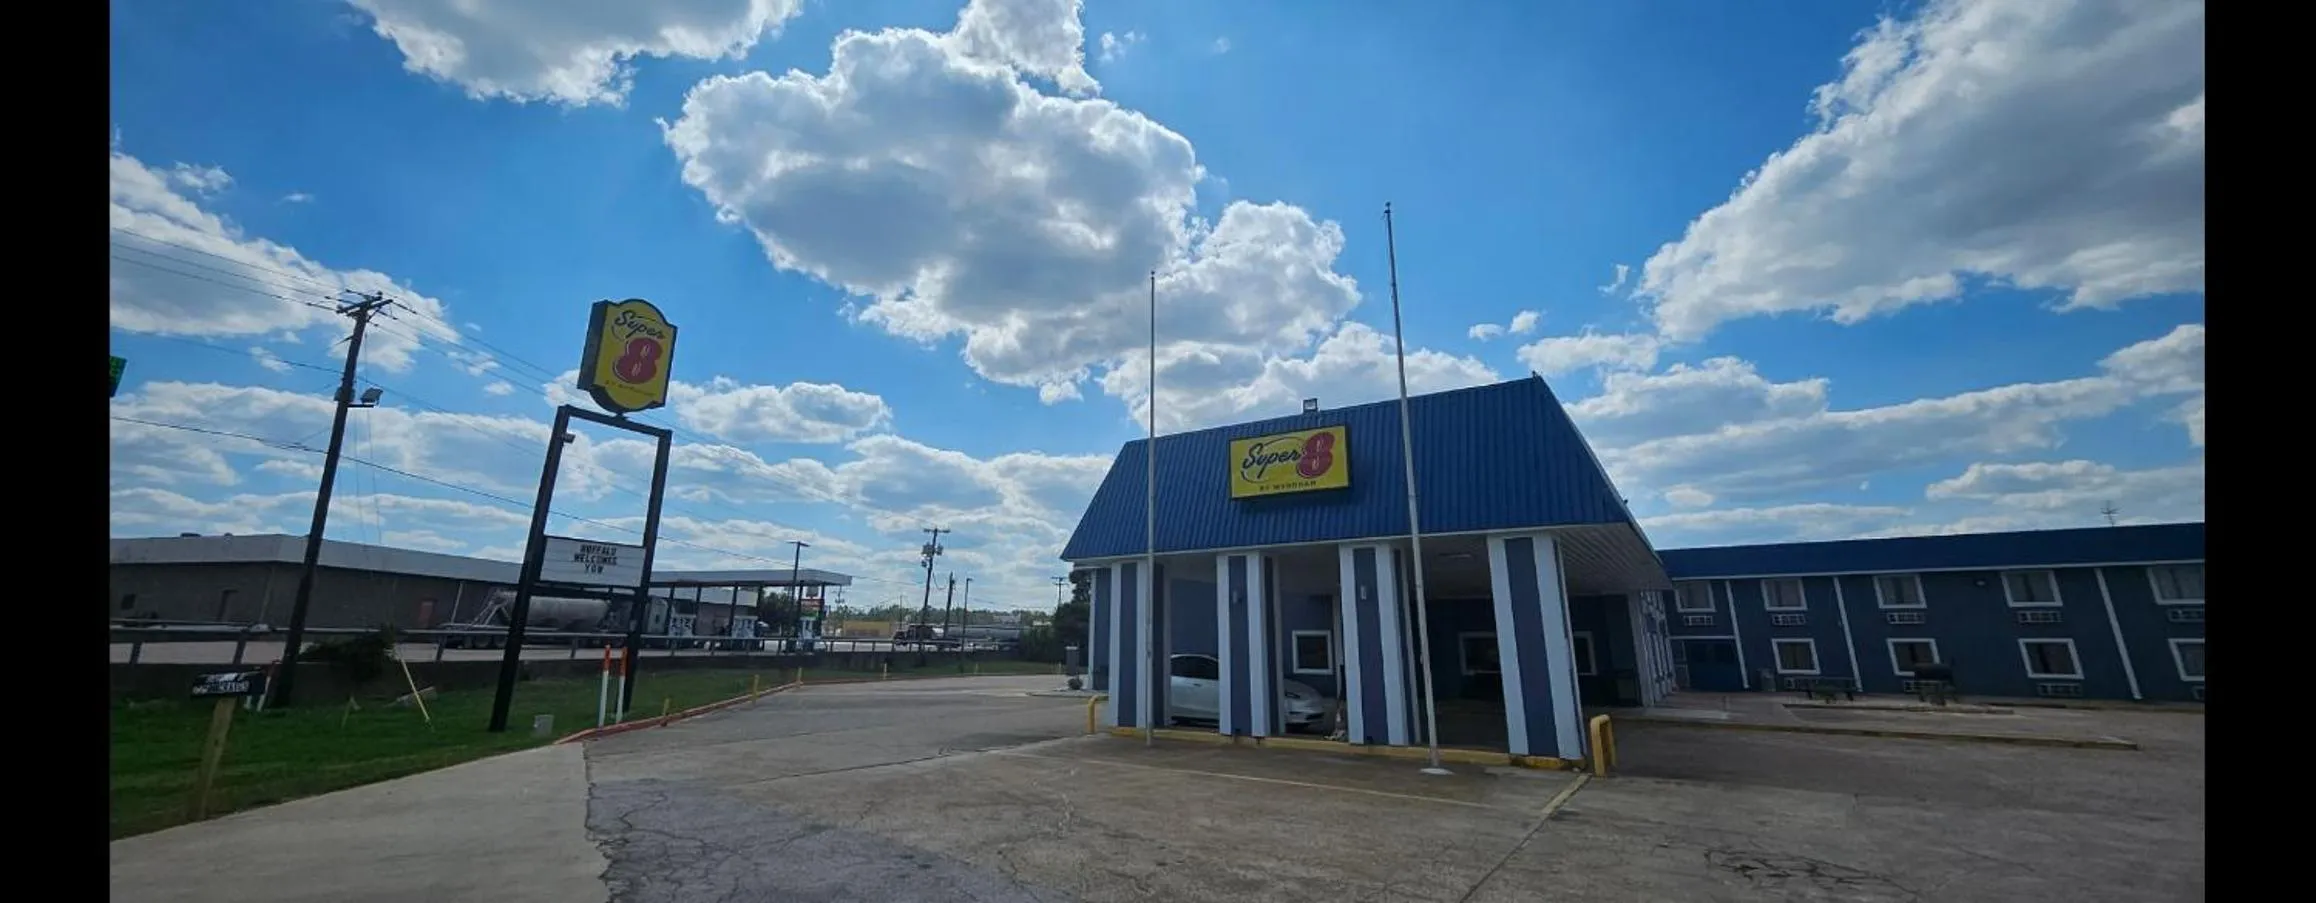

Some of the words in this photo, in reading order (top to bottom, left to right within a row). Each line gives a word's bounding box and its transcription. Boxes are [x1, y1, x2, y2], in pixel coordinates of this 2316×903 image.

[613, 310, 664, 339] Super
[612, 337, 663, 385] 8
[1242, 442, 1303, 480] Super
[1296, 431, 1336, 479] 8
[580, 544, 616, 556] BUFFALO
